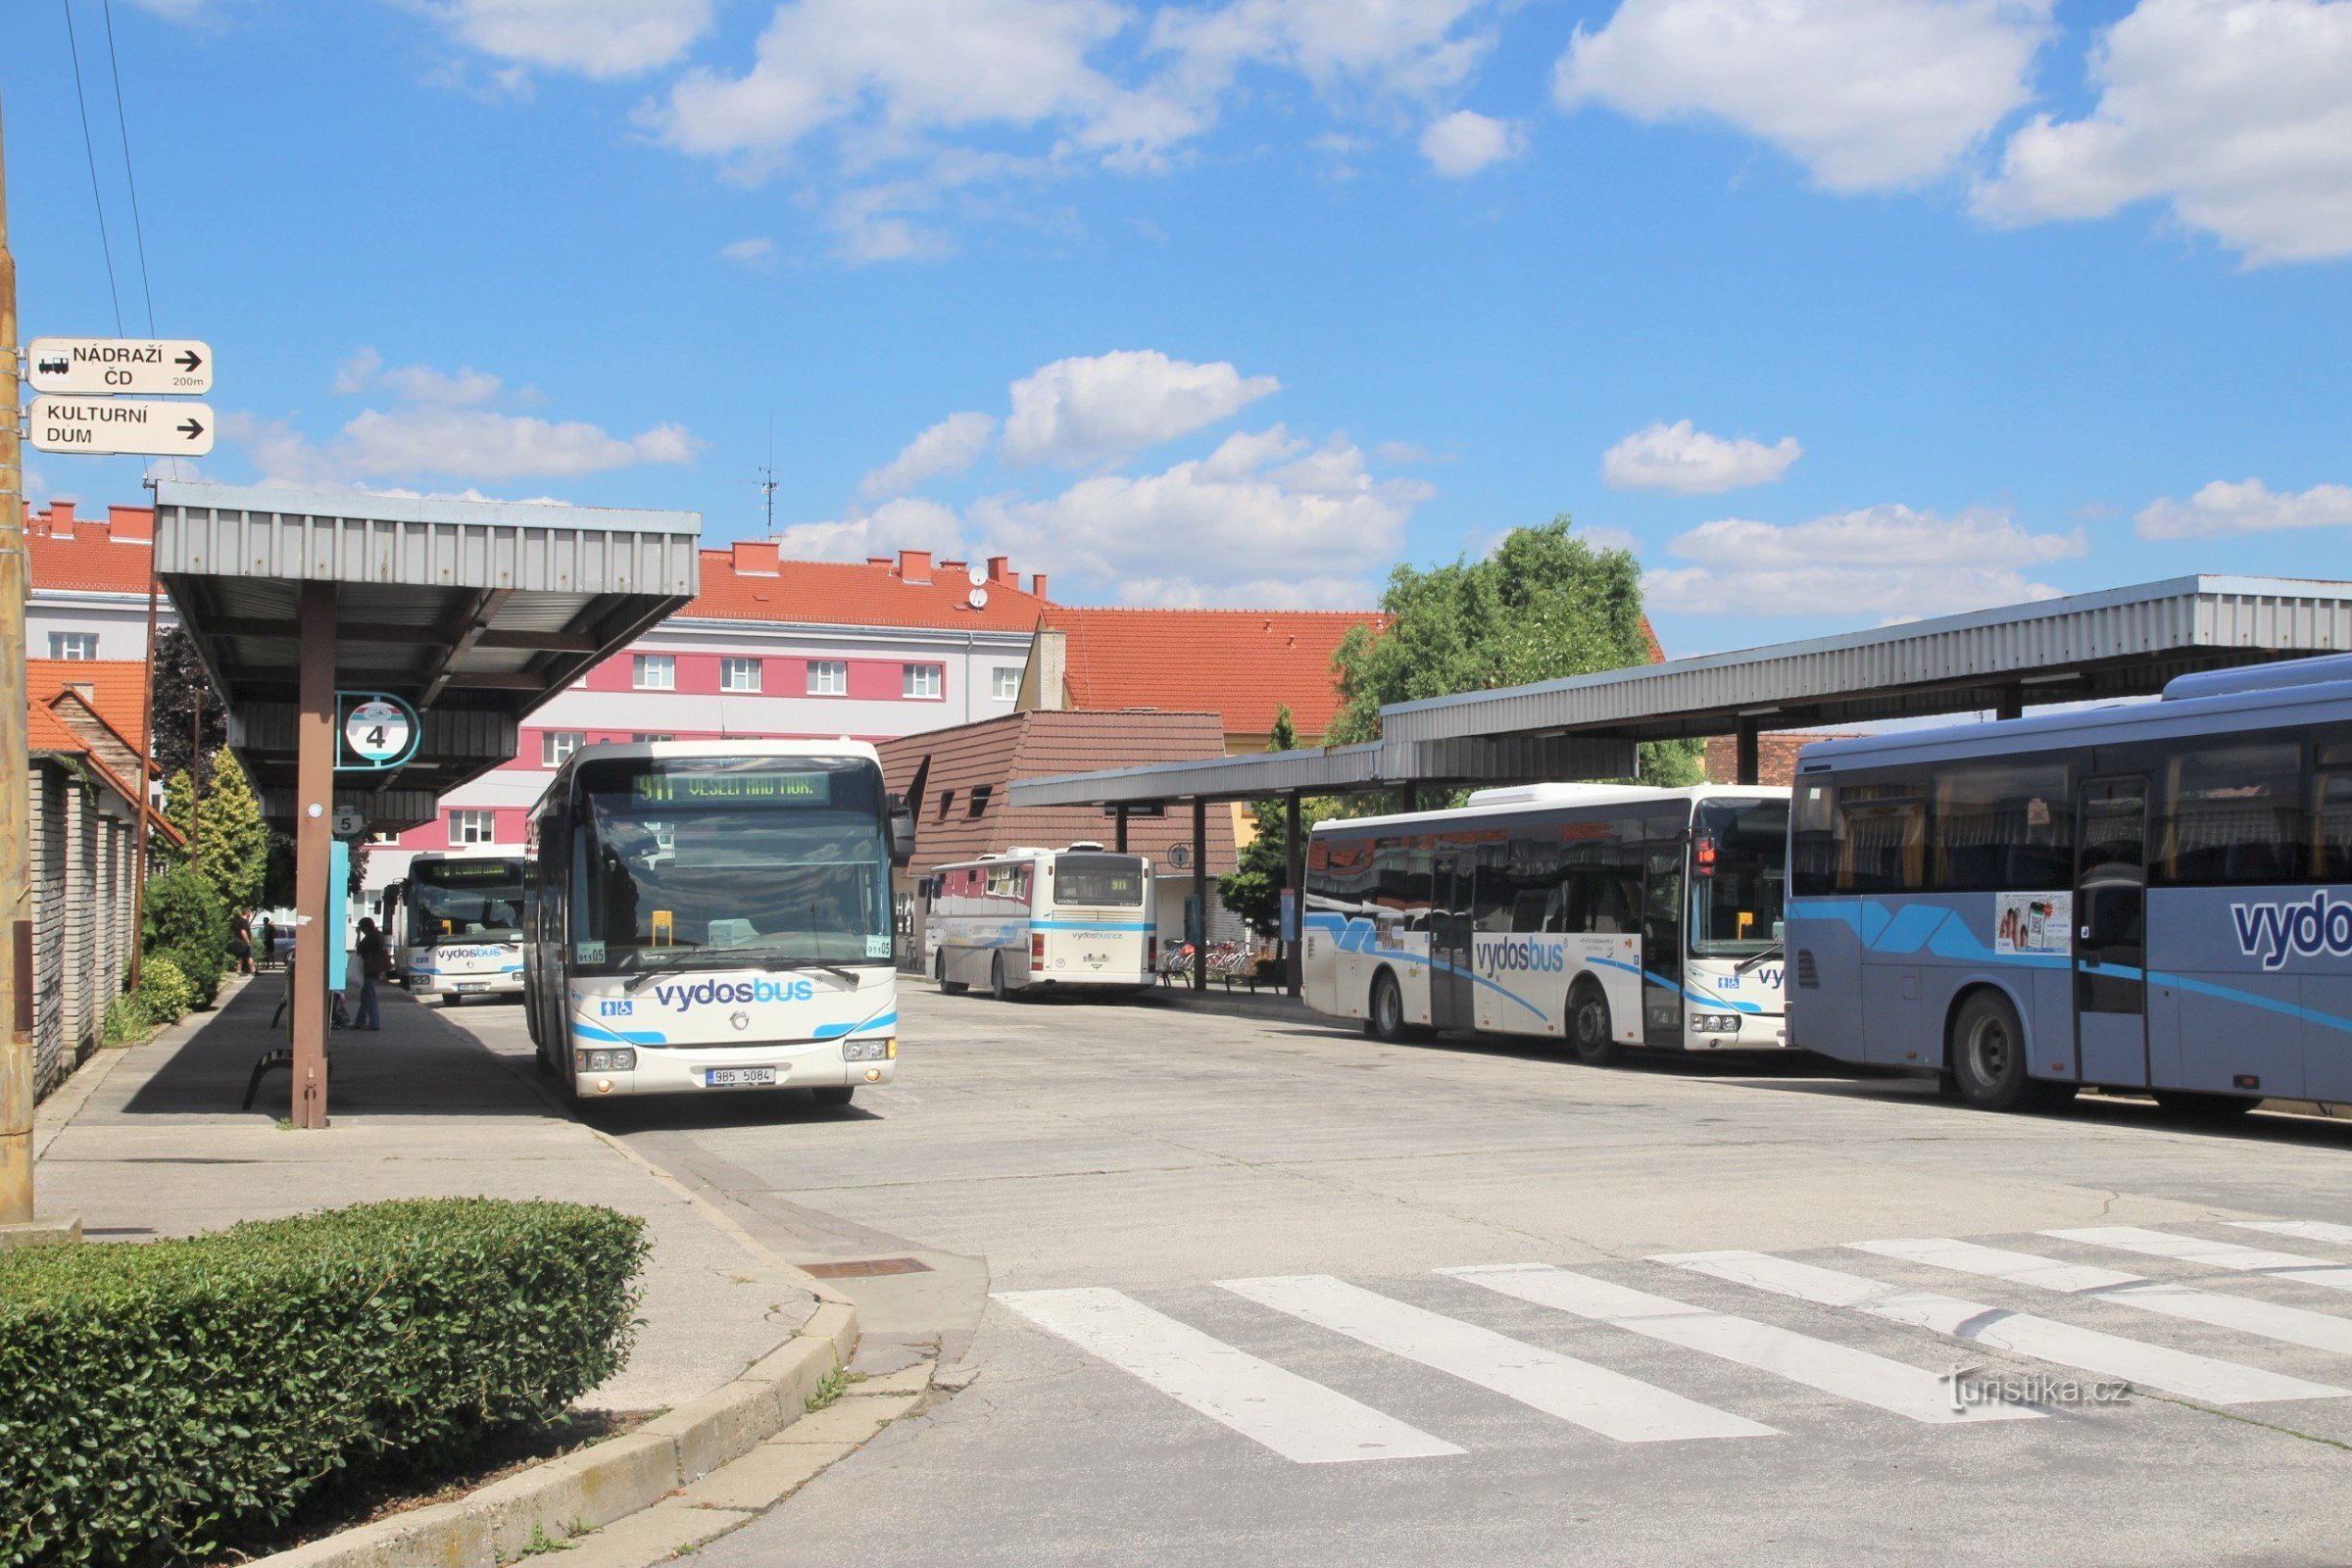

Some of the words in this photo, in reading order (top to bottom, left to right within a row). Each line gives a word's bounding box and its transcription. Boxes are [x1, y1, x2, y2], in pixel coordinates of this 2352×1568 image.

[74, 343, 163, 363] NÁDRAŽÍ
[105, 367, 132, 385] ČD
[172, 377, 204, 386] 200m
[48, 405, 148, 423] KULTURNÍ
[366, 725, 385, 749] 4
[341, 817, 352, 831] 5
[1111, 879, 1127, 891] 911
[2230, 889, 2352, 970] vydo
[437, 947, 502, 961] vydosbus
[1476, 935, 1564, 978] vydosbus
[655, 977, 813, 1012] vydosbus
[743, 1069, 770, 1081] 5084
